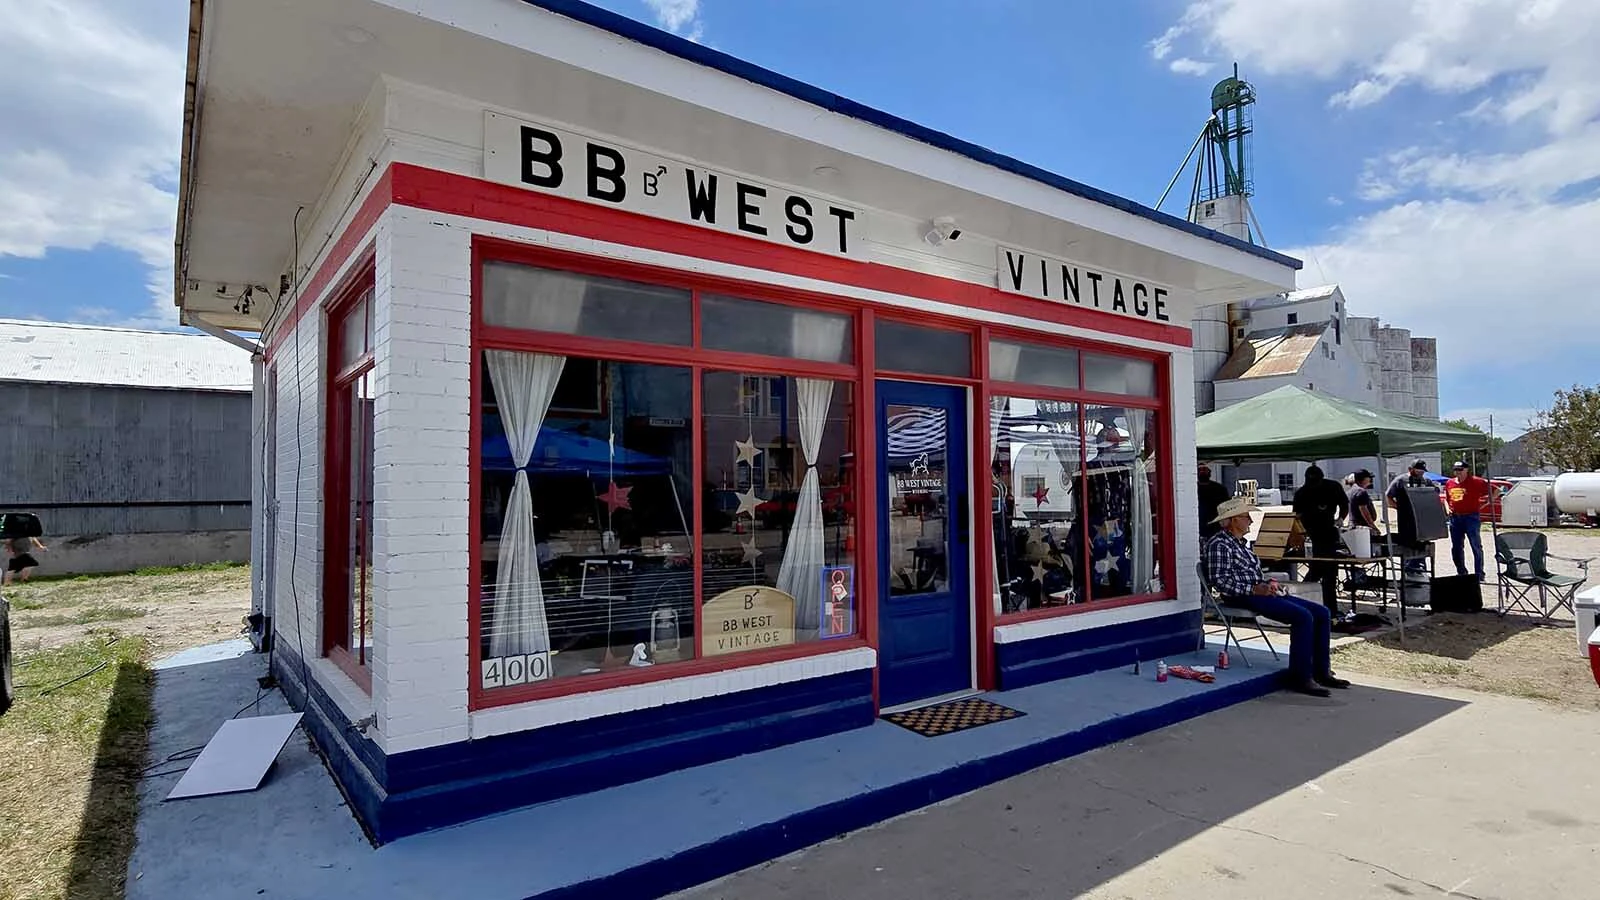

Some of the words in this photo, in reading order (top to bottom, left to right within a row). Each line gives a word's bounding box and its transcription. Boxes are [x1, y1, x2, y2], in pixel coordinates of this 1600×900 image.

[520, 125, 627, 203] BB
[685, 168, 855, 254] WEST
[1006, 251, 1169, 321] VINTAGE
[723, 619, 738, 632] BB
[742, 615, 773, 630] WEST
[831, 569, 845, 634] OPEN
[718, 631, 780, 649] VINTAGE
[485, 657, 545, 683] 400
